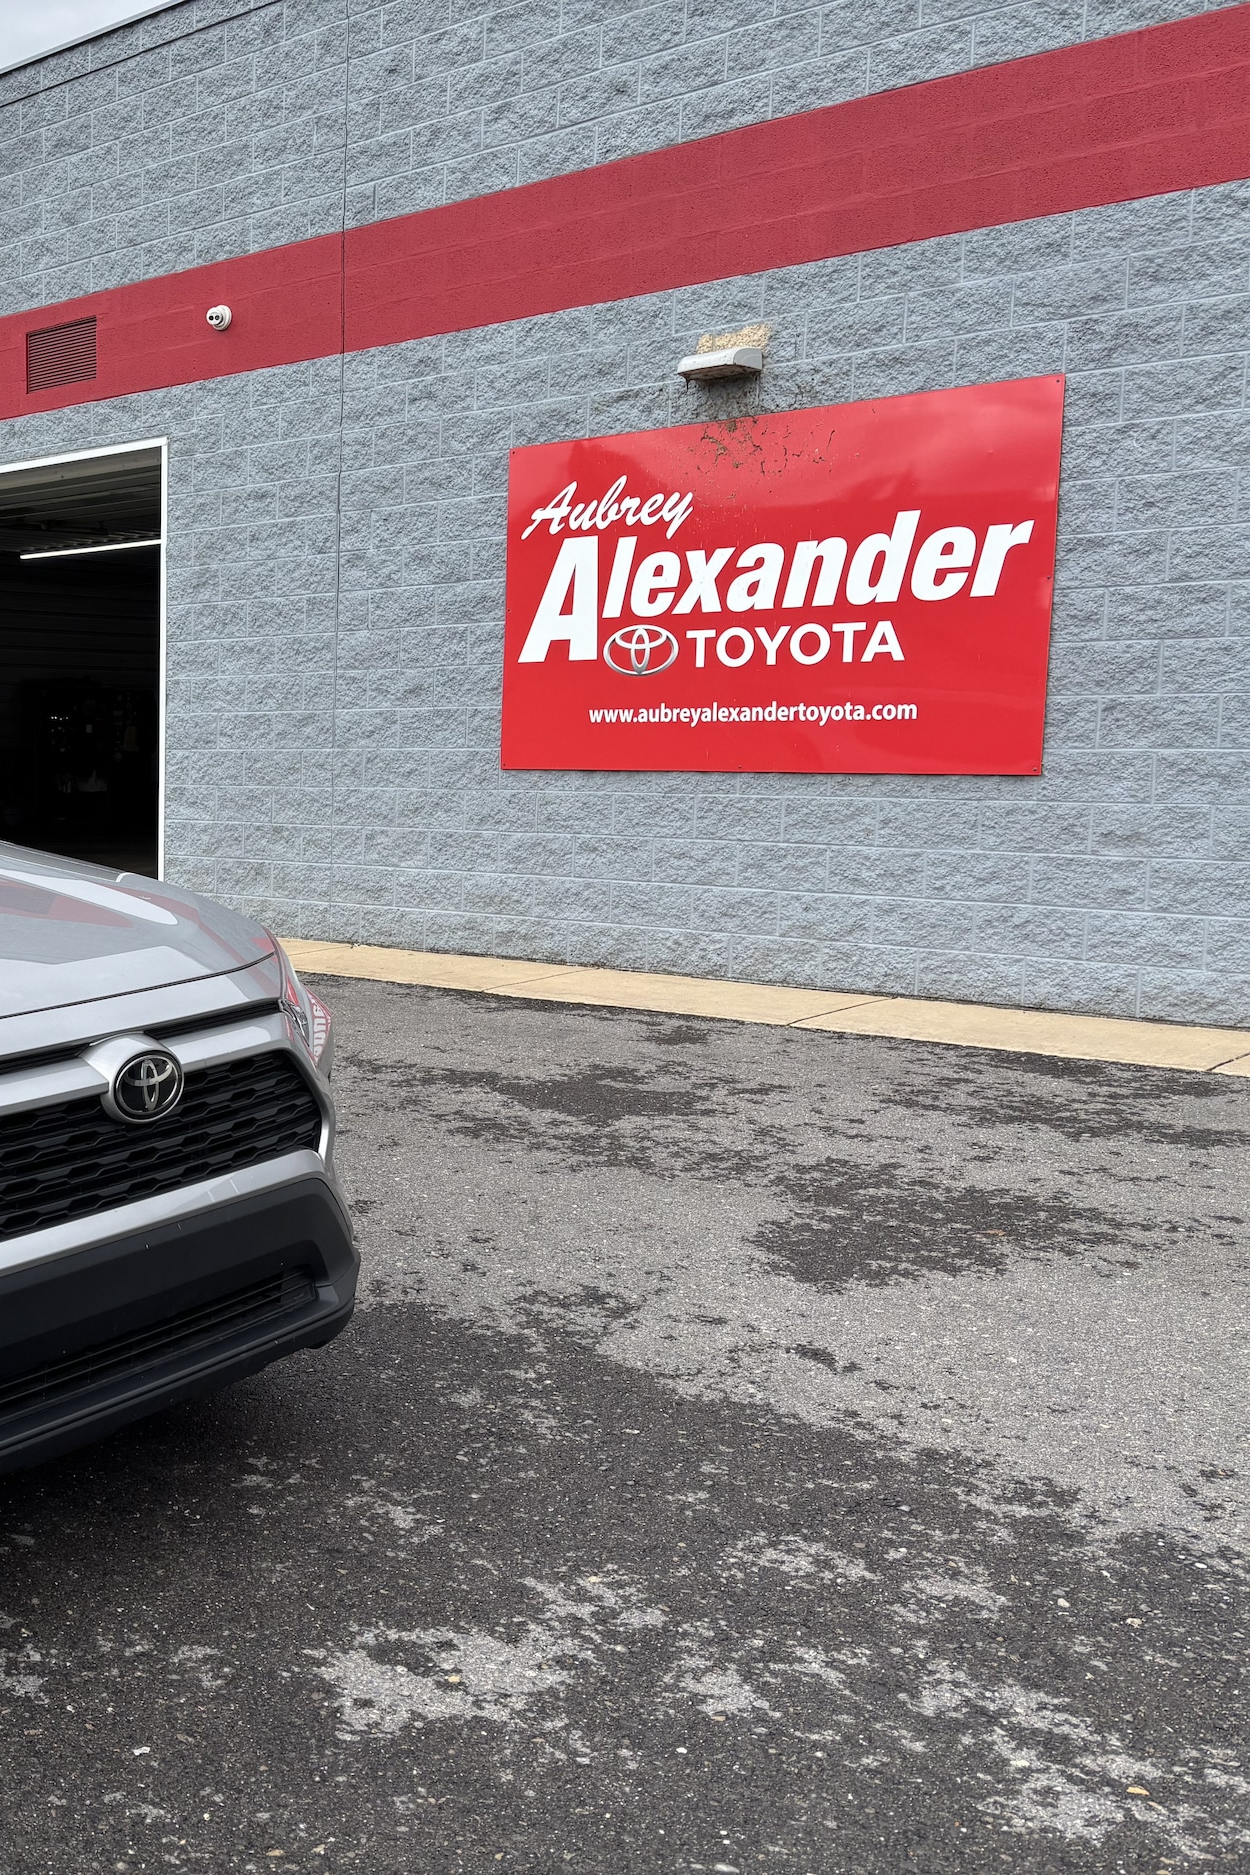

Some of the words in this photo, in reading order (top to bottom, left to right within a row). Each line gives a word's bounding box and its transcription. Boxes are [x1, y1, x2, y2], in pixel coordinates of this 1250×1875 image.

[521, 474, 694, 540] Aubrey
[517, 509, 1035, 663] Alexander
[685, 620, 905, 668] TOYOTA
[588, 698, 918, 728] www.aubreyalexandertoyota.com
